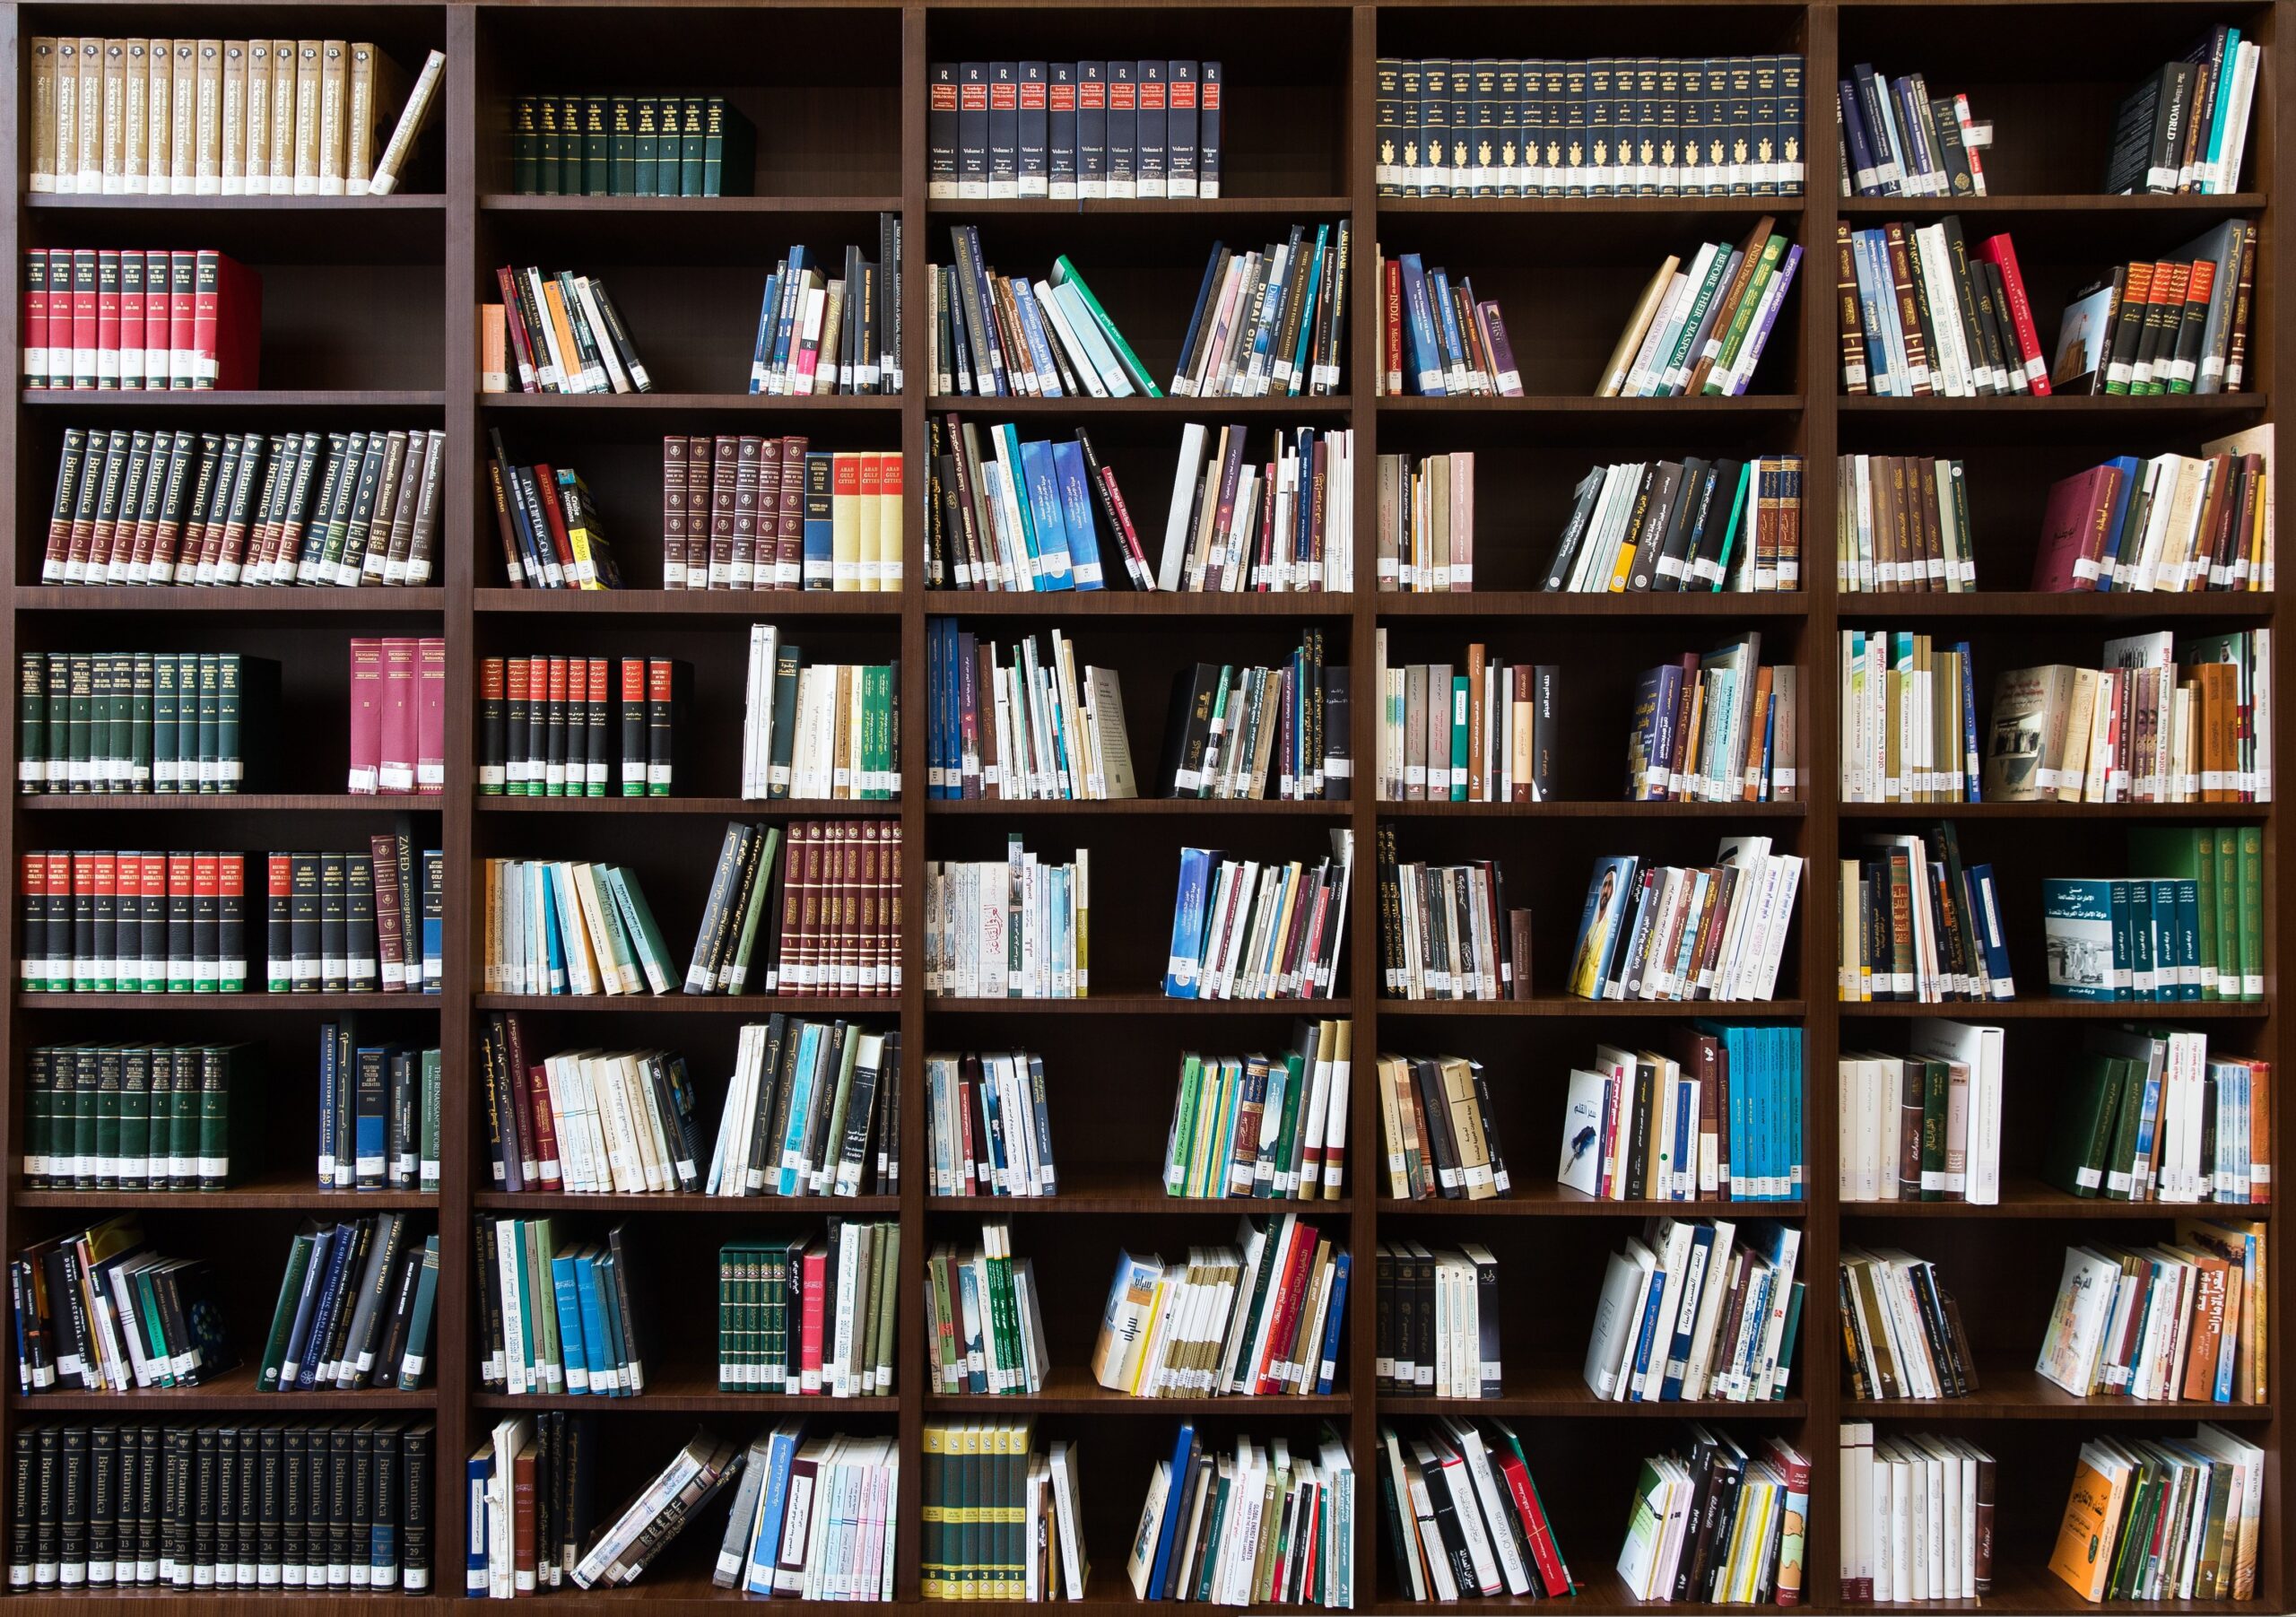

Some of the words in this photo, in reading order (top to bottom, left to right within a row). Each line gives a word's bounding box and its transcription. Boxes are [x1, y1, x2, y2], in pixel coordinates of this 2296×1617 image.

[942, 71, 947, 79] R
[971, 70, 978, 79] R
[1030, 68, 1036, 78] R
[1089, 68, 1095, 77] R
[61, 76, 70, 111] Science
[326, 79, 335, 113] Science
[2167, 104, 2181, 140] WORLD
[58, 119, 68, 175] Technology
[250, 123, 259, 174] Technology
[323, 120, 332, 174] Technology
[1709, 254, 1726, 287] BEFORE
[1749, 243, 1763, 267] INDIA
[968, 295, 976, 309] THE
[1024, 296, 1038, 330] Education
[1250, 283, 1266, 322] DUBAI
[1265, 285, 1277, 309] Dubai
[1390, 295, 1398, 323] INDIA
[1696, 291, 1712, 317] THEIR
[971, 310, 981, 336] UNITED
[976, 337, 984, 356] ARAB
[1241, 328, 1256, 359] CITY
[1672, 322, 1699, 370] DIASPORA
[59, 456, 77, 513] Britannica
[82, 457, 100, 514] Britannica
[103, 457, 122, 514] Britannica
[145, 457, 165, 515] Britannica
[167, 457, 186, 515] Britannica
[193, 460, 213, 517] Britannica
[291, 459, 312, 515] Britannica
[318, 460, 339, 516] Britannica
[337, 459, 358, 515] Britannica
[1097, 475, 1108, 498] SHEIKH
[1105, 497, 1115, 516] ZAYED
[1107, 472, 1115, 487] From
[1120, 508, 1130, 527] Riches
[563, 491, 574, 522] Vacations
[570, 496, 579, 516] Cruise
[399, 836, 409, 871] ZAYED
[403, 882, 412, 936] photographic
[376, 1265, 388, 1294] WORLD
[71, 1297, 82, 1338] PICTORIAL
[1495, 1512, 1508, 1537] Words
[39, 1543, 48, 1551] 16
[66, 1543, 74, 1551] 15
[142, 1540, 150, 1548] 18
[1508, 1550, 1518, 1570] Echo
